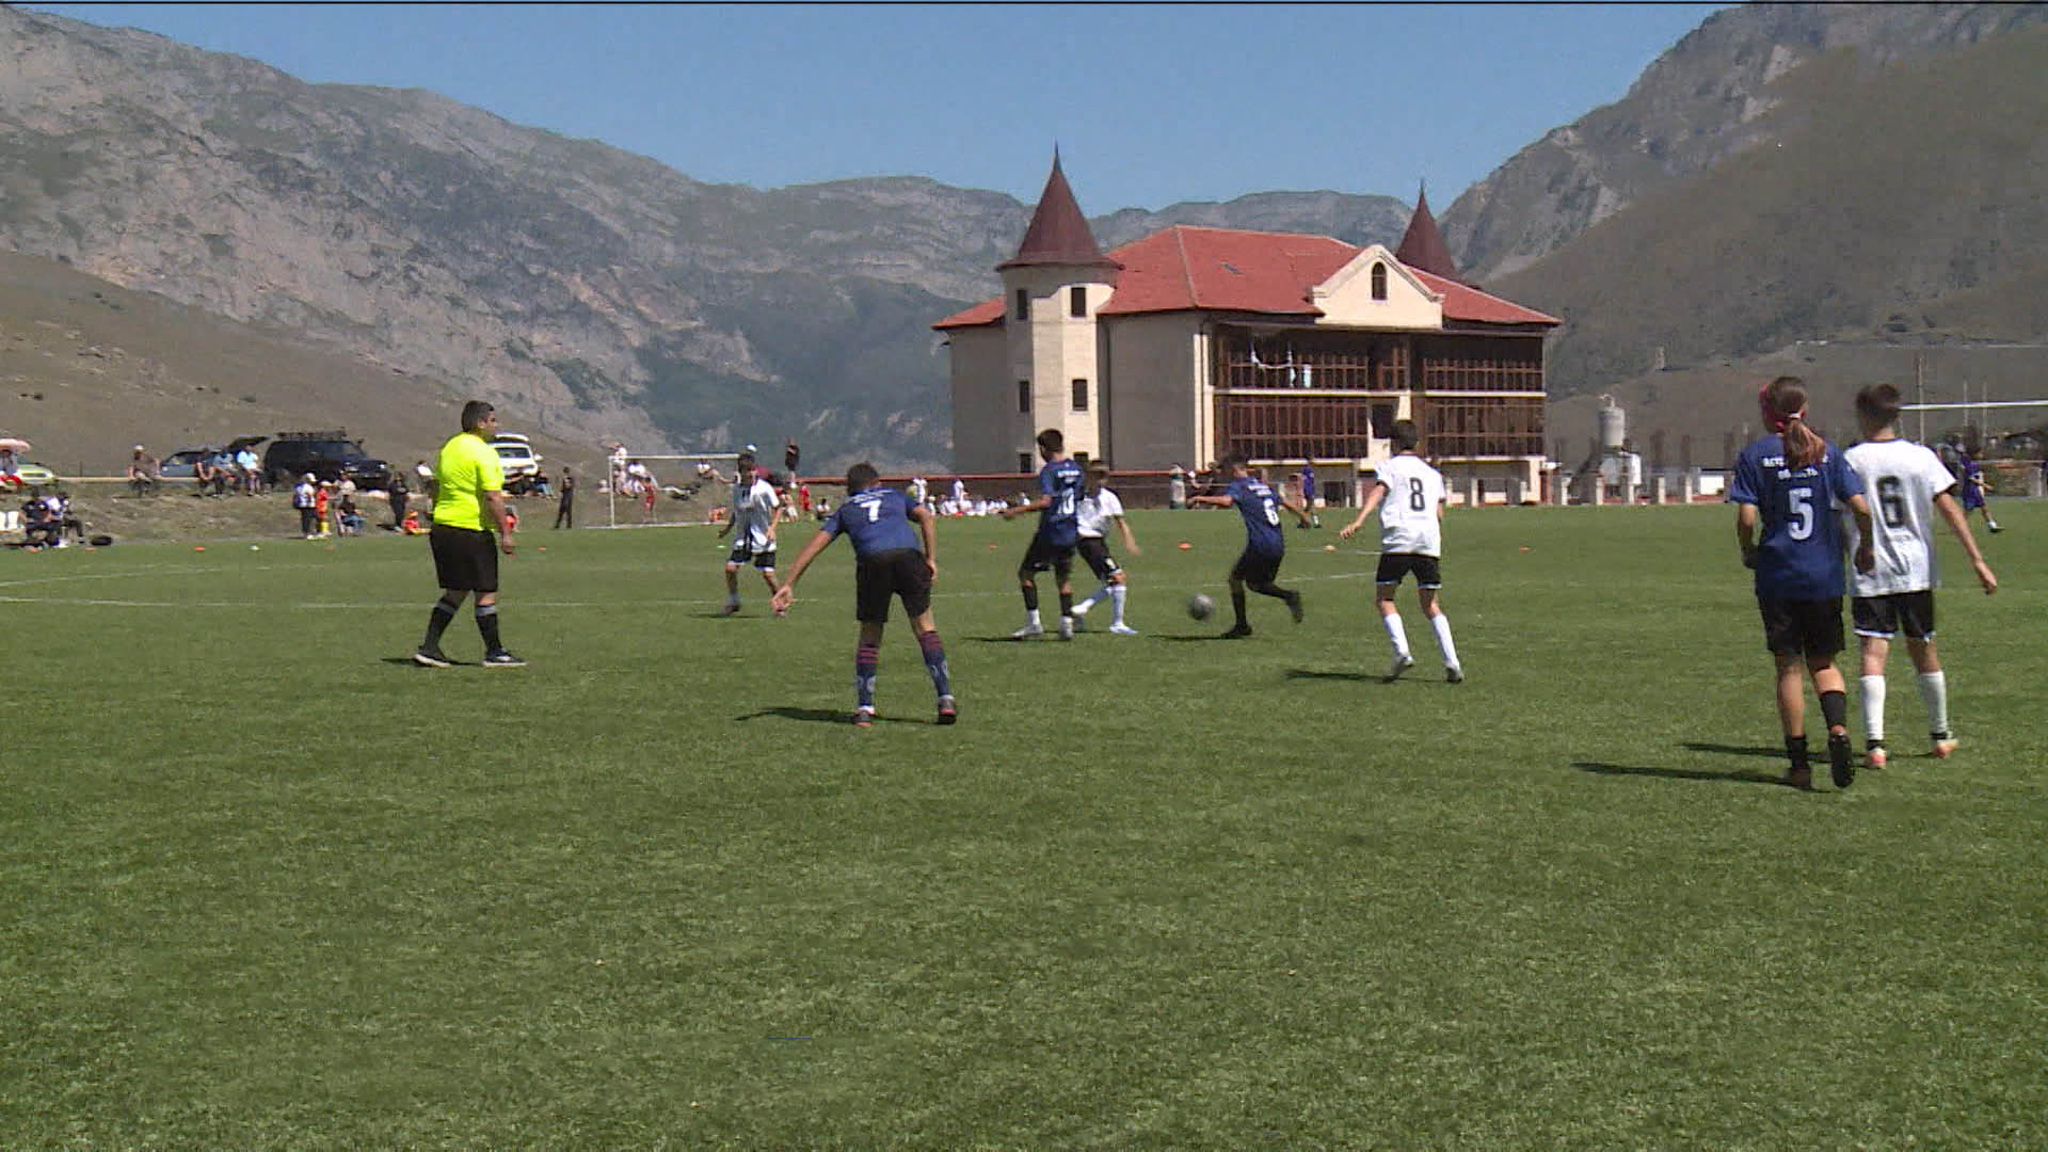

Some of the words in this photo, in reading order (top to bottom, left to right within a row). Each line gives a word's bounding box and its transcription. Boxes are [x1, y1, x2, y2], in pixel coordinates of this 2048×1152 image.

[1409, 476, 1425, 512] 8
[860, 499, 882, 522] 7
[1263, 498, 1279, 526] 6
[1787, 487, 1813, 540] 5
